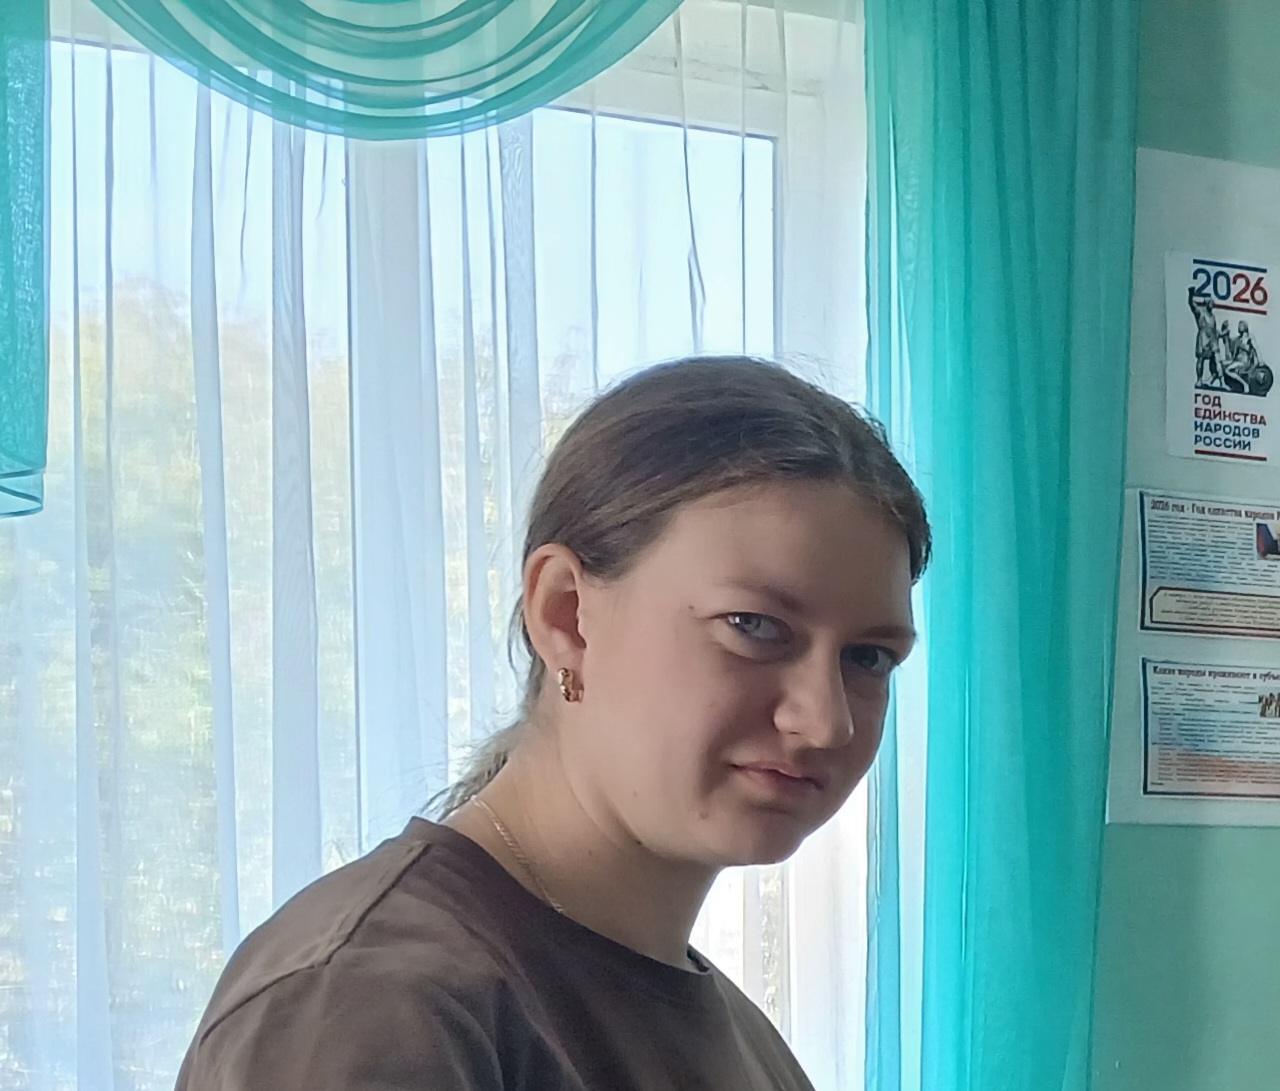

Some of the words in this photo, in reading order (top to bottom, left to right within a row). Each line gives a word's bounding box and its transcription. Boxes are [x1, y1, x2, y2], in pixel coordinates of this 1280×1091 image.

[1192, 268, 1268, 306] 2026
[1194, 393, 1222, 409] ГОД
[1194, 407, 1267, 426] ЕДИНСТВА
[1194, 420, 1260, 438] НАРОДОВ
[1194, 434, 1251, 451] РОССИИ
